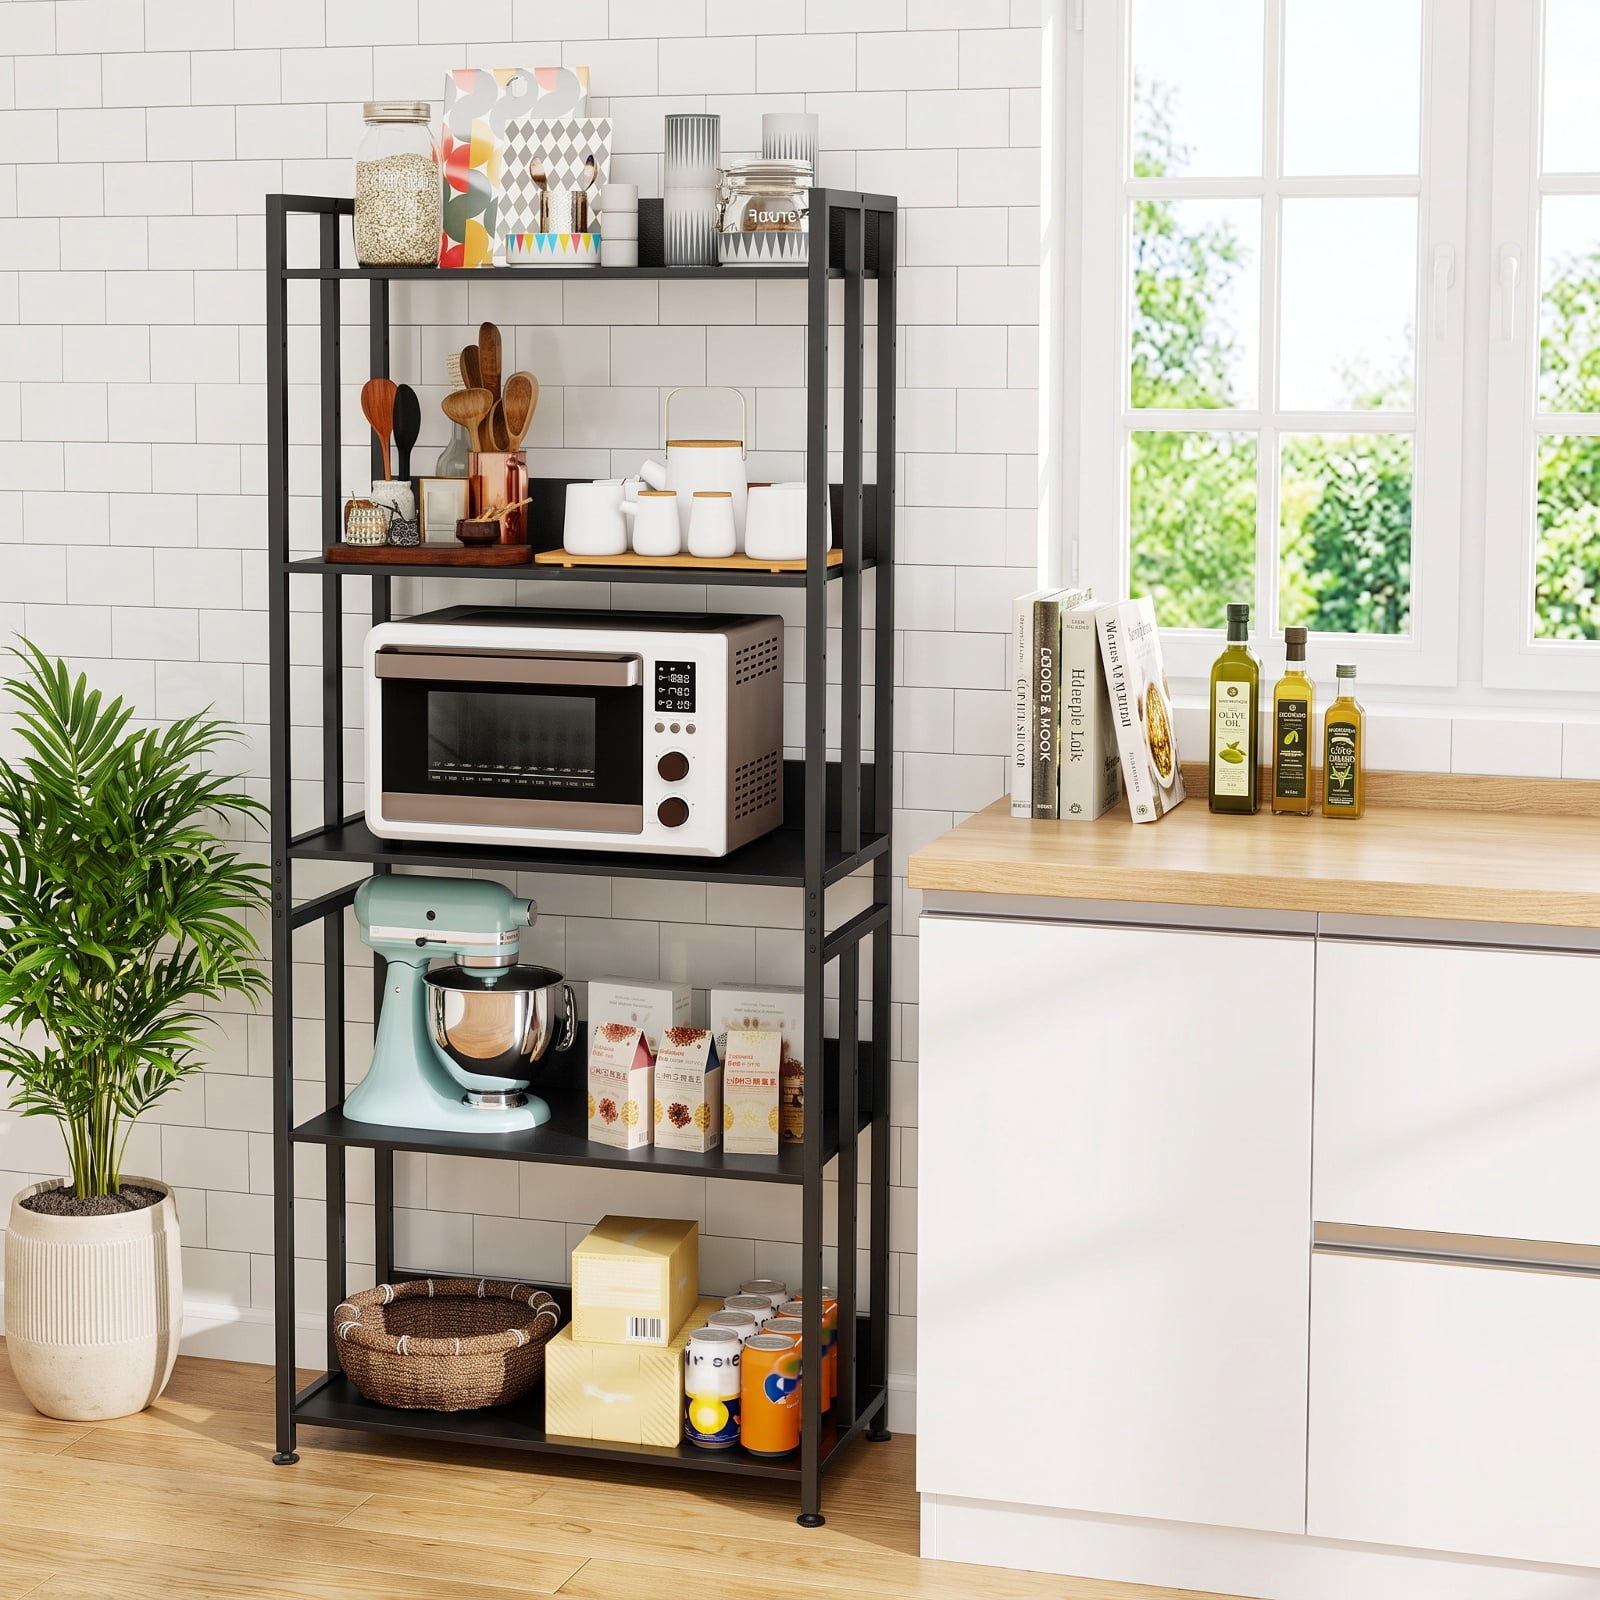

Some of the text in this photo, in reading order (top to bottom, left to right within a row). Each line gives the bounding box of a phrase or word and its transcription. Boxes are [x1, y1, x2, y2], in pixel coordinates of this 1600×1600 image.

[1218, 711, 1247, 720] OLIVE
[1225, 719, 1241, 728] OIL
[1039, 718, 1051, 761] MOOK
